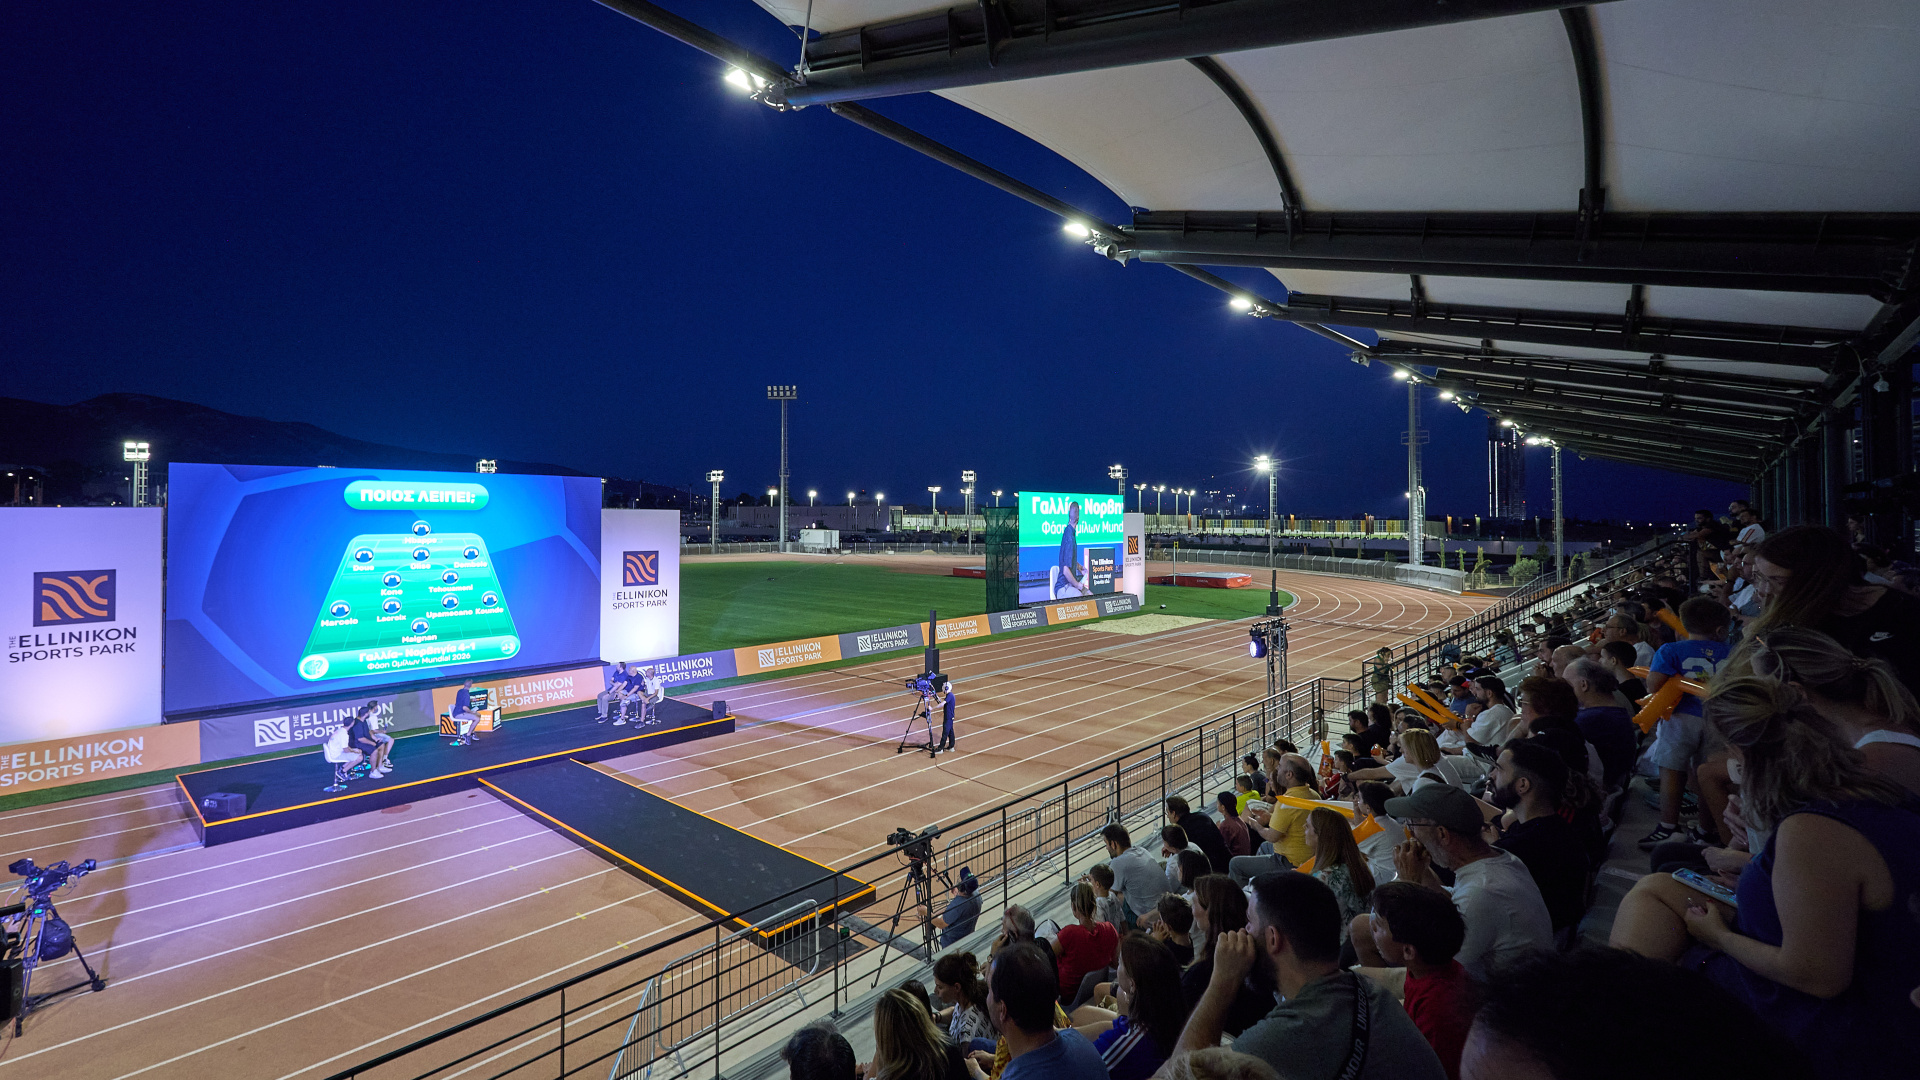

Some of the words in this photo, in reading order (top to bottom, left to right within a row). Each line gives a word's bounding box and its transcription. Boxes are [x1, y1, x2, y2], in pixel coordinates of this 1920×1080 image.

[360, 489, 414, 502] ΠΟΙΟΣ
[418, 490, 476, 504] ΛΕΙΠΕΙ;
[1085, 498, 1123, 518] Νορβη
[1076, 521, 1100, 536] μίλων
[616, 589, 668, 600] ELLINIKON
[612, 600, 645, 610] SPORTS
[647, 599, 667, 607] PARK
[948, 629, 967, 639] SPORTS
[967, 627, 979, 636] PARK
[949, 619, 977, 632] ELLINIKON
[19, 627, 137, 648] ELLINIKON
[872, 640, 895, 650] SPORTS
[895, 638, 909, 647] PARK
[873, 629, 908, 643] ELLINIKON
[9, 647, 83, 663] SPORTS
[89, 642, 136, 656] PARK
[405, 642, 456, 658] Νορβηγία
[458, 641, 476, 651] 4-1
[778, 642, 821, 657] ELLINIKON
[367, 661, 390, 670] Φάση
[391, 658, 420, 669] Ομίλων
[452, 652, 471, 661] 2026
[659, 656, 713, 674] ELLINIKON
[776, 655, 804, 666] SPORTS
[804, 651, 823, 661] PARK
[657, 671, 690, 684] SPORTS
[692, 668, 714, 679] PARK
[504, 676, 574, 696] ELLINIKON
[500, 694, 543, 709] SPORTS
[546, 688, 574, 701] PARK
[11, 736, 144, 769] ELLINIKON
[0, 763, 84, 787] SPORTS
[91, 754, 143, 773] PARK
[1356, 988, 1368, 1032] UNDER
[1339, 1038, 1366, 1080] MOUR
